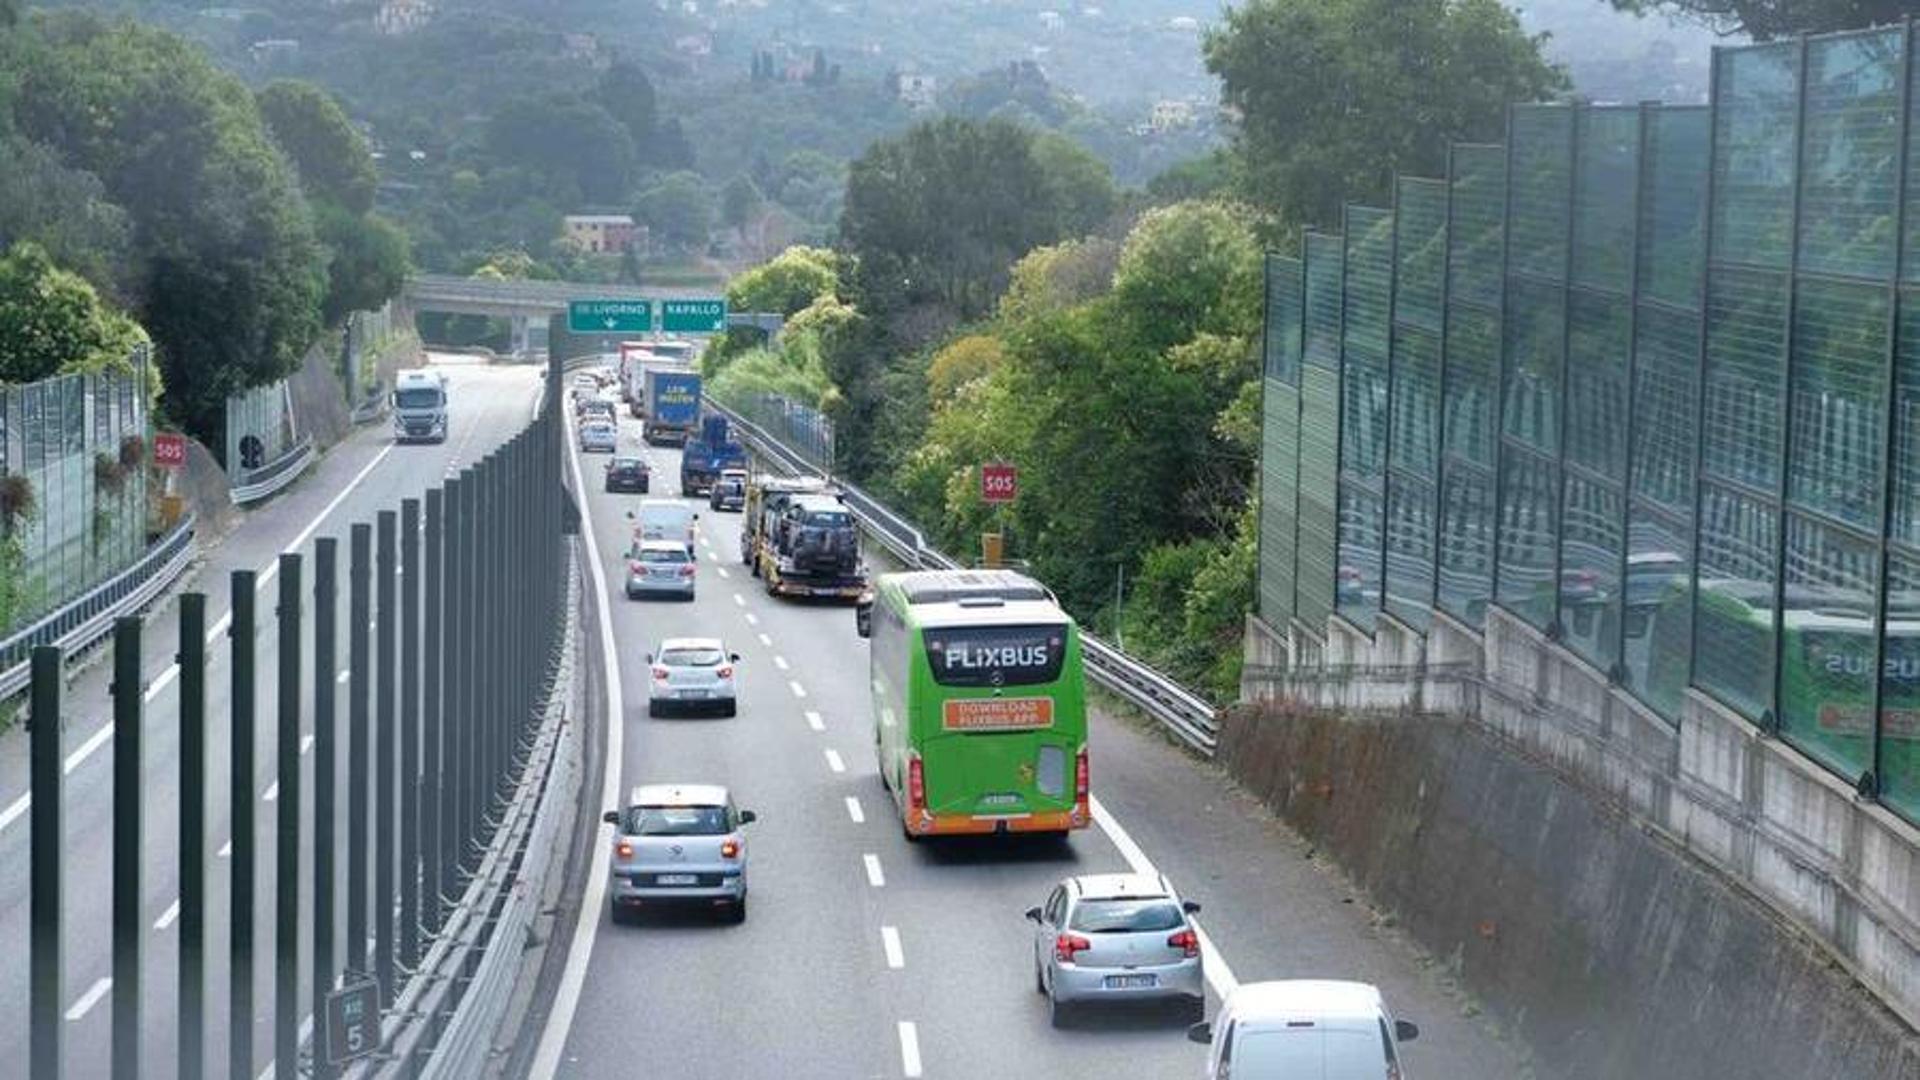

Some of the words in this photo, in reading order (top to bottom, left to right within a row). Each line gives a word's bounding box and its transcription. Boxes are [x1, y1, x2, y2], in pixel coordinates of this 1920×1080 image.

[157, 443, 182, 459] SOS
[986, 476, 1012, 491] SOS
[958, 701, 1038, 714] DOWNLOAD
[1013, 713, 1040, 725] APP
[347, 1024, 362, 1052] 5
